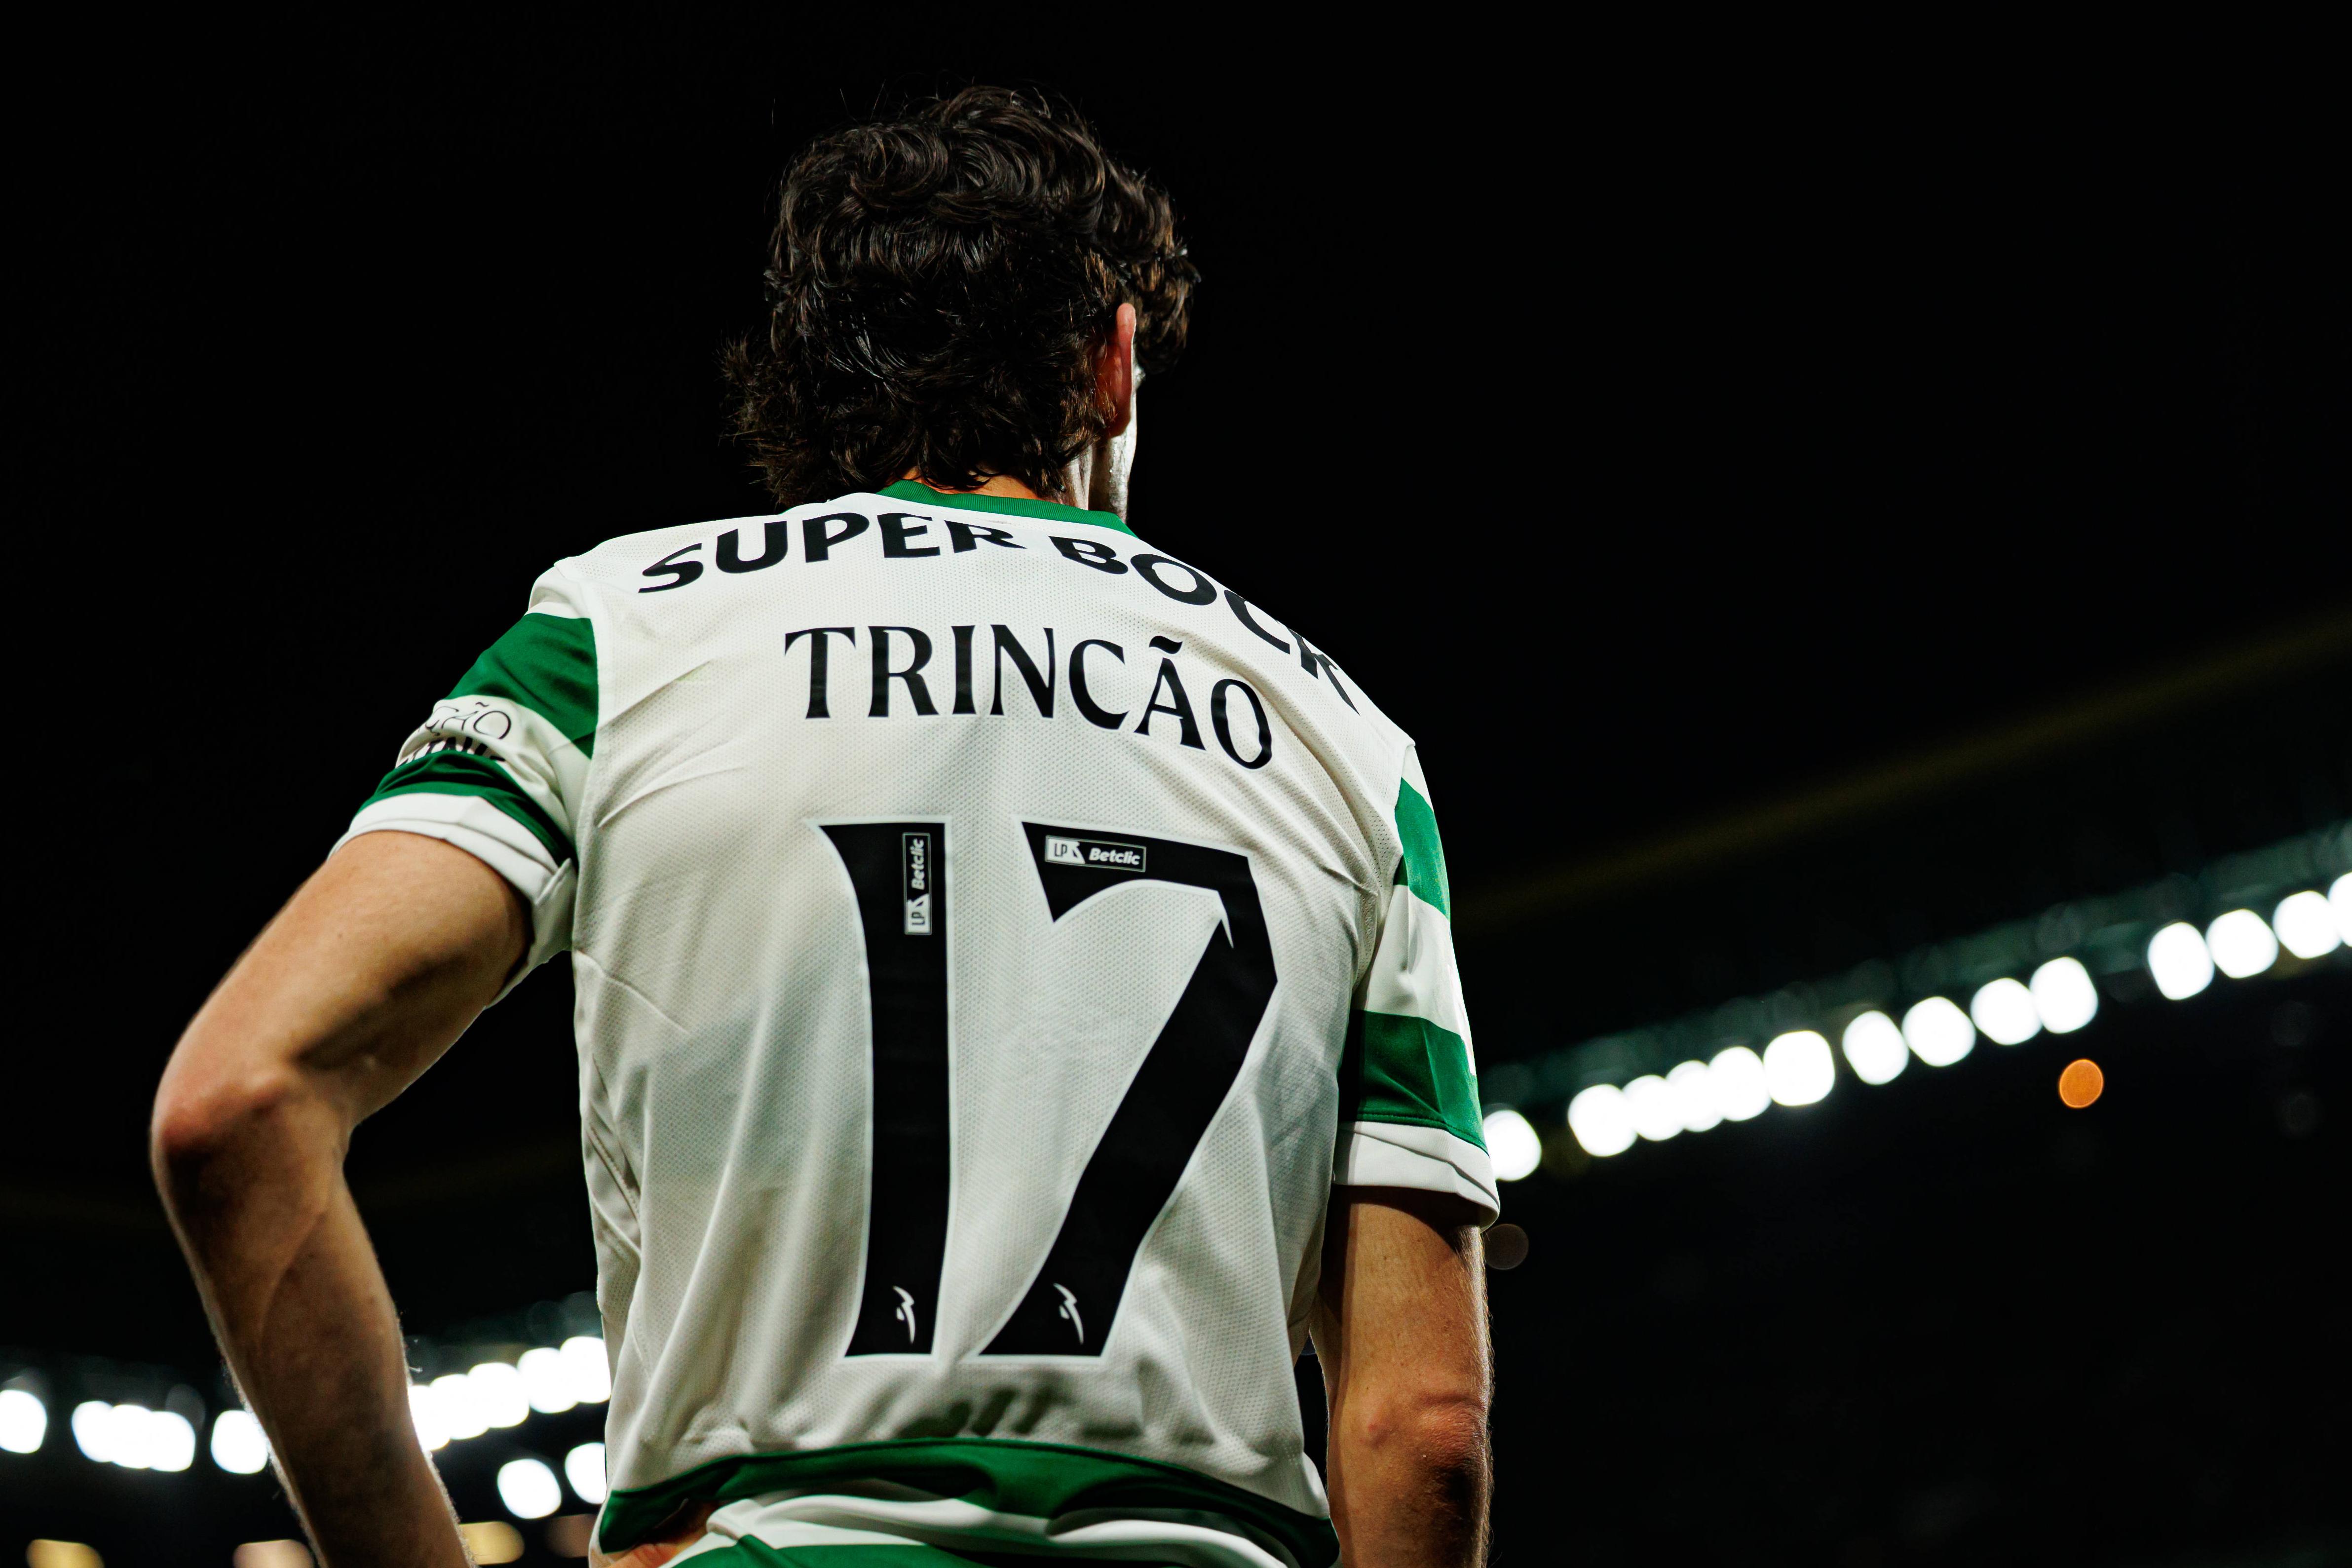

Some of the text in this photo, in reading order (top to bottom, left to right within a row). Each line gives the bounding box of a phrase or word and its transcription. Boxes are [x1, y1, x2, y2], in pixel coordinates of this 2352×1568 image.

[638, 512, 1361, 716] SUPER BOCK
[785, 624, 1273, 770] TRINCÃO
[909, 838, 925, 890] Betclic
[1089, 847, 1140, 865] Betclic
[818, 821, 1279, 1357] 17
